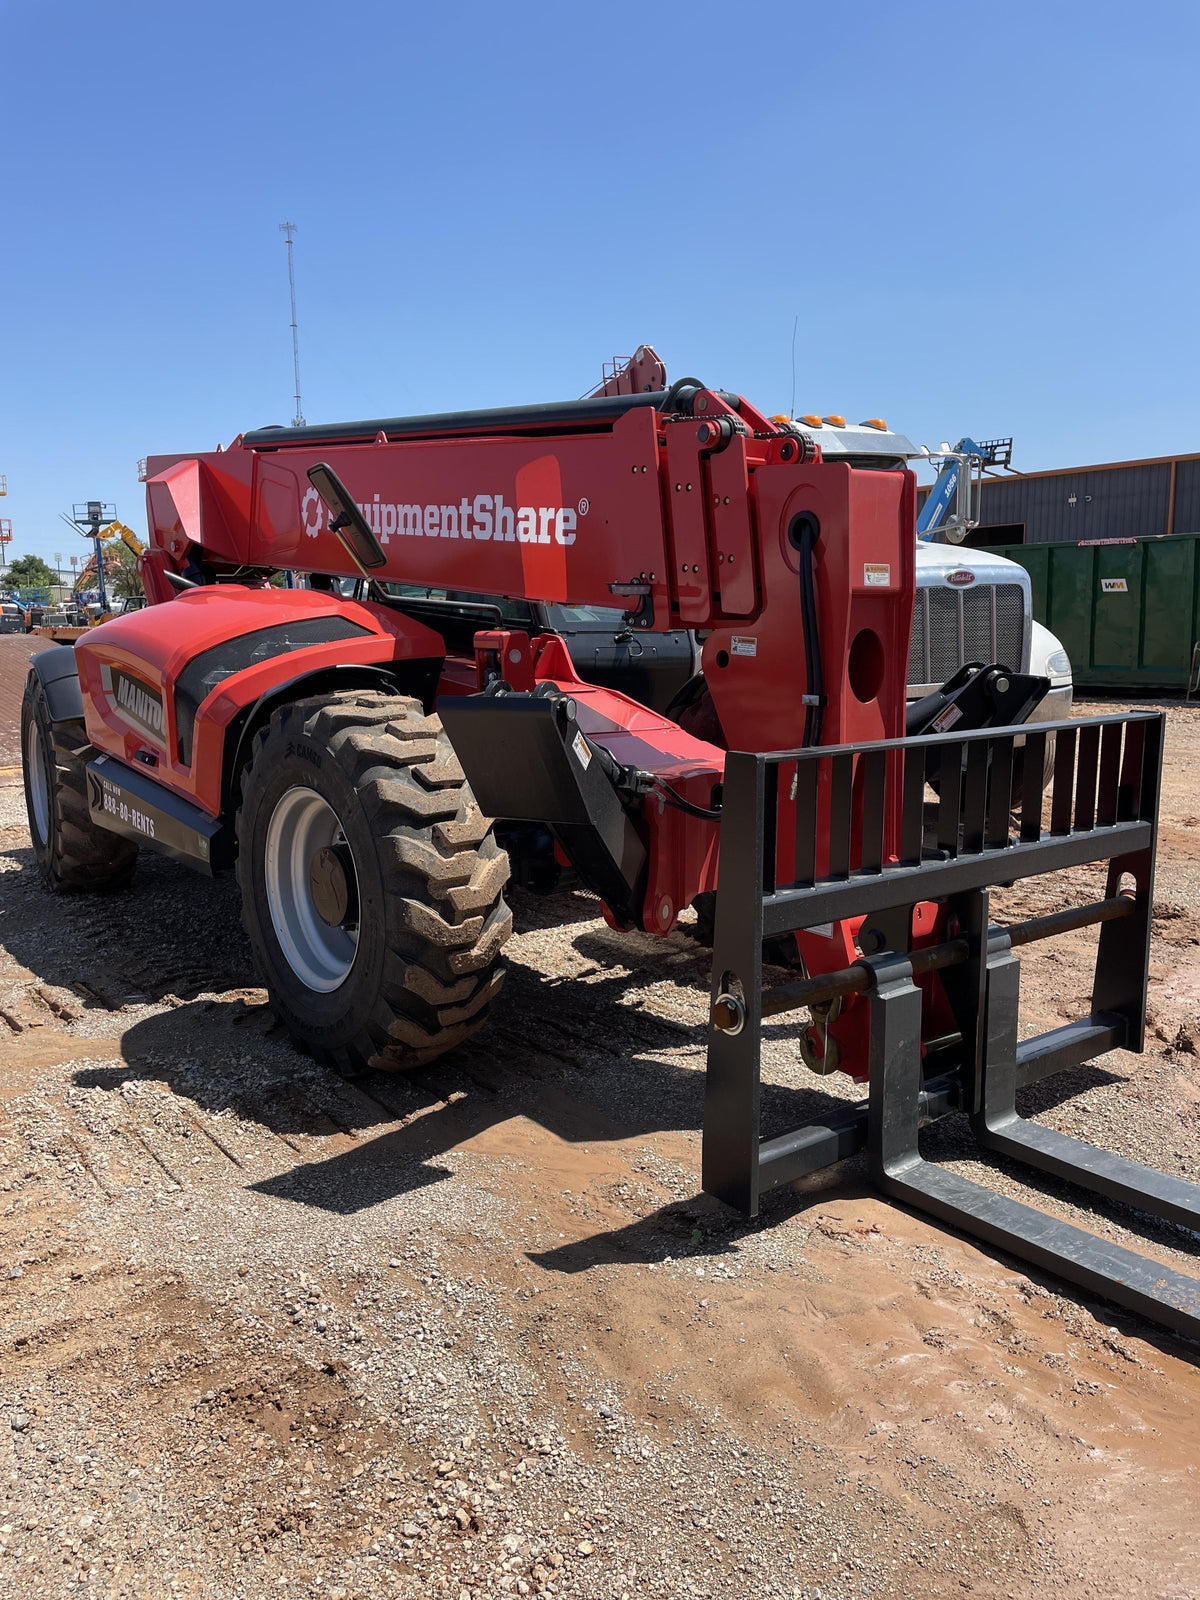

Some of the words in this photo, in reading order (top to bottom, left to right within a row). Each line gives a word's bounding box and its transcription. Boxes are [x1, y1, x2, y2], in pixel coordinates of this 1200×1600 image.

[327, 494, 577, 545] uipmentShare
[103, 780, 113, 792] CALL
[103, 793, 155, 838] 888-80-RENTS
